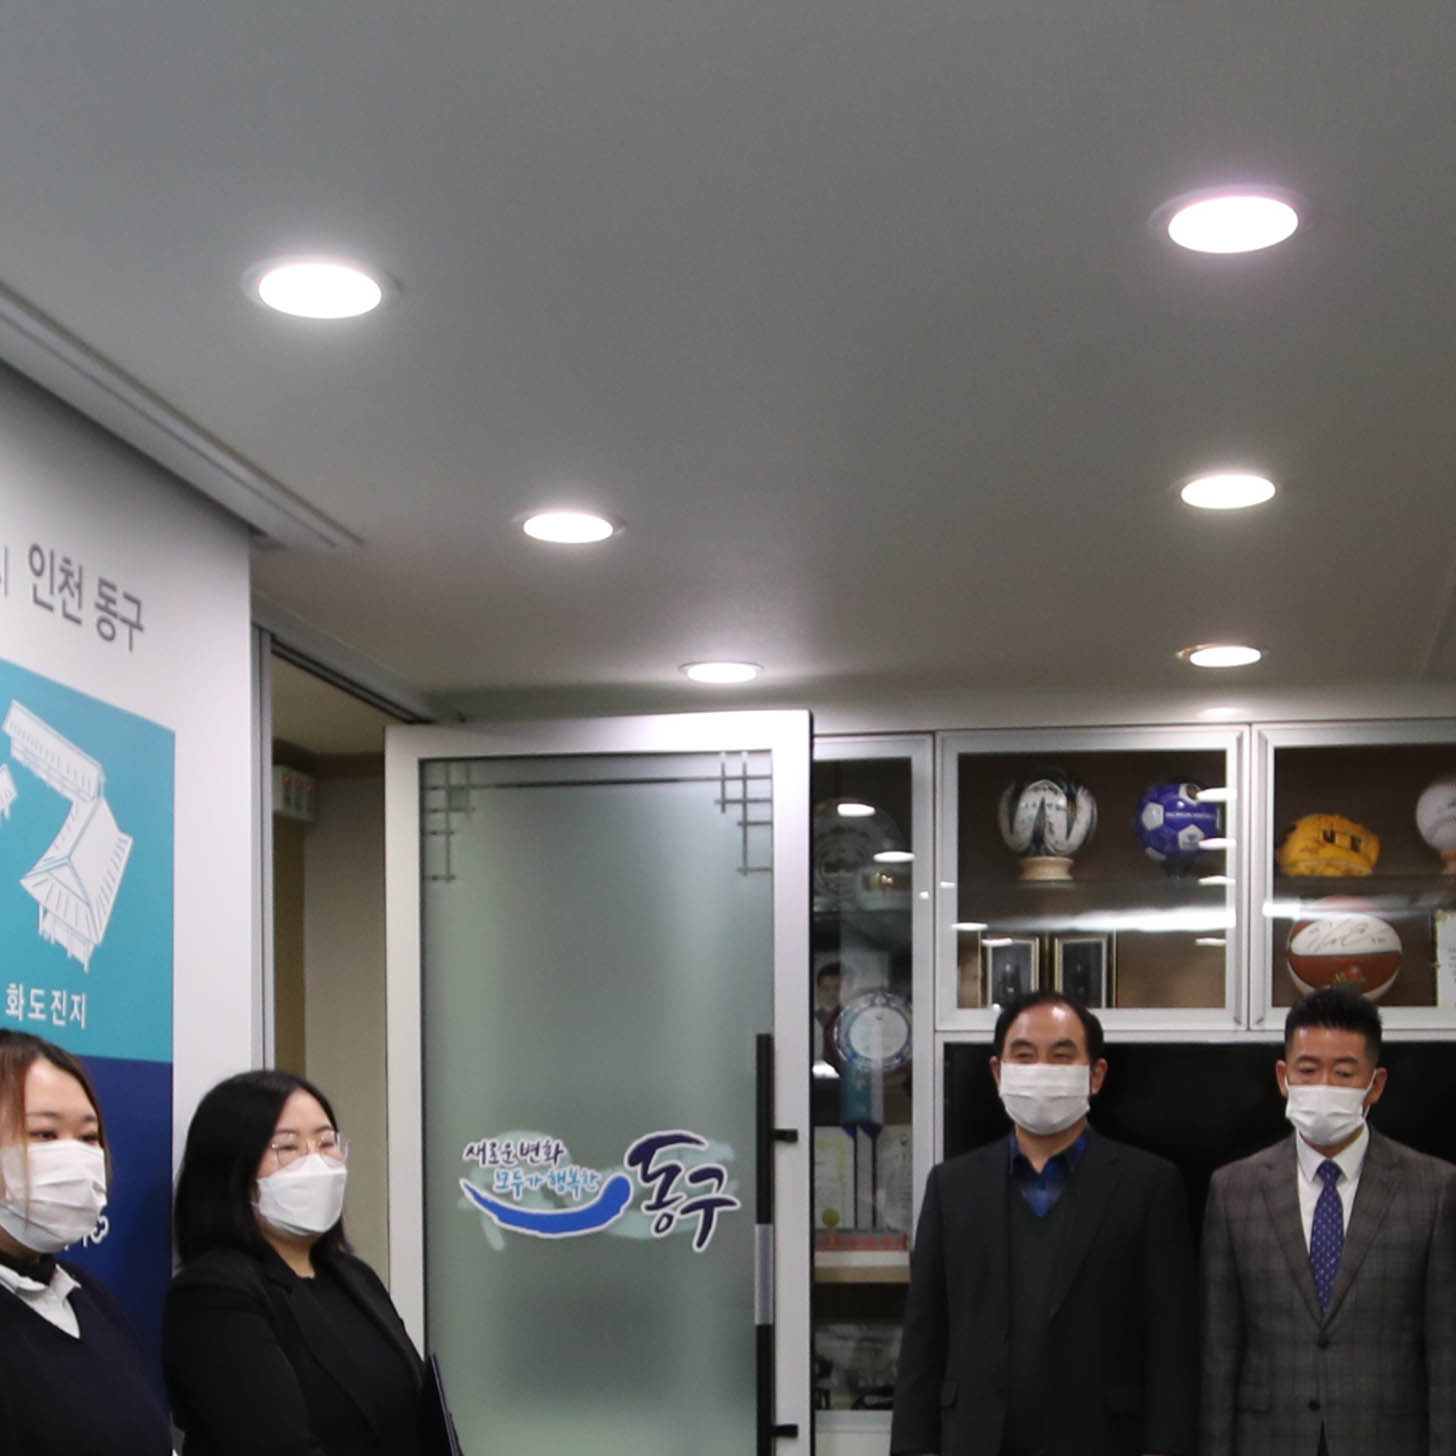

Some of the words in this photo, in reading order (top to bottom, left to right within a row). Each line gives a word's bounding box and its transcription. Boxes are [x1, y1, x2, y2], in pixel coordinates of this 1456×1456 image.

[27, 542, 84, 627] 인천
[93, 576, 145, 653] 동구
[4, 982, 88, 1030] 화도진지
[463, 1138, 517, 1167] 새로운
[518, 1140, 566, 1165] 변화
[494, 1168, 544, 1199] 모두가
[546, 1164, 601, 1200] 행복한
[625, 1130, 741, 1252] 동구
